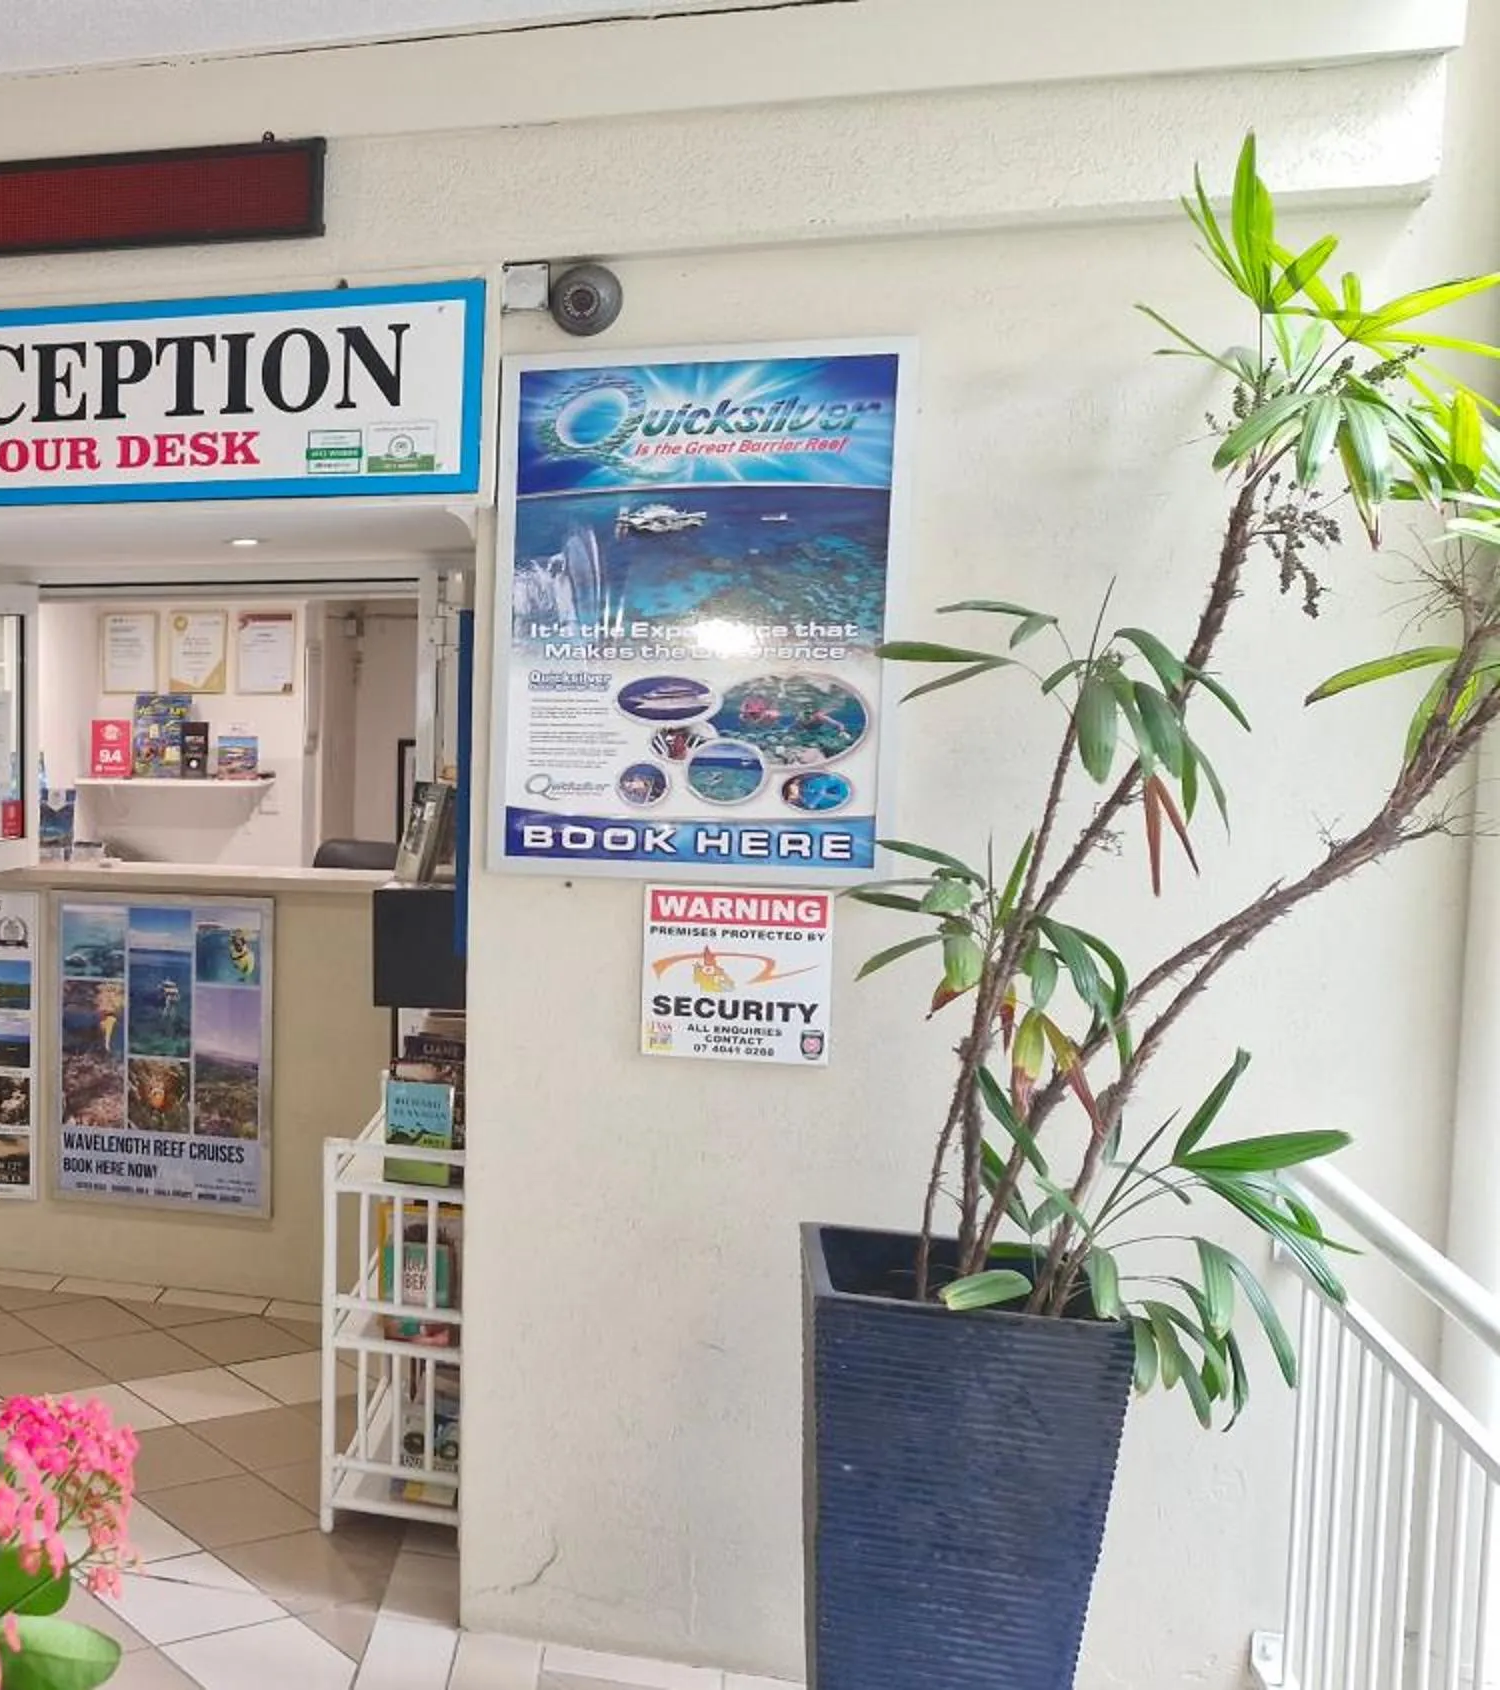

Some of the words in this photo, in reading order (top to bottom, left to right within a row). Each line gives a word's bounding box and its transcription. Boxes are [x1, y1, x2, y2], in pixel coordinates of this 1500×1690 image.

[537, 374, 882, 480] Quicksilver
[116, 430, 260, 471] DESK
[635, 443, 649, 457] Is
[652, 442, 683, 456] the
[685, 440, 736, 456] Great
[738, 438, 803, 454] Barrier
[805, 437, 850, 454] Reef
[530, 622, 574, 638] It's
[581, 621, 627, 638] the
[795, 621, 860, 638] that
[544, 644, 635, 661] Makes
[641, 644, 686, 661] the
[528, 670, 613, 685] Quicksilver
[522, 826, 678, 854] BOOK
[697, 831, 853, 860] HERE
[657, 895, 821, 923] WARNING
[650, 926, 717, 938] PREMISES
[721, 929, 803, 942] PROTECTED
[807, 933, 826, 942] BY
[652, 995, 819, 1024] SECURITY
[687, 1024, 710, 1033] ALL
[713, 1025, 782, 1037] ENQUIRIES
[705, 1035, 764, 1046] CONTACT
[63, 1132, 151, 1157] WAVELENGTH
[154, 1138, 186, 1158] REEF
[189, 1143, 245, 1164] CRUISES
[63, 1156, 93, 1174] BOOK
[95, 1160, 125, 1176] HERE
[127, 1163, 158, 1179] NOW!
